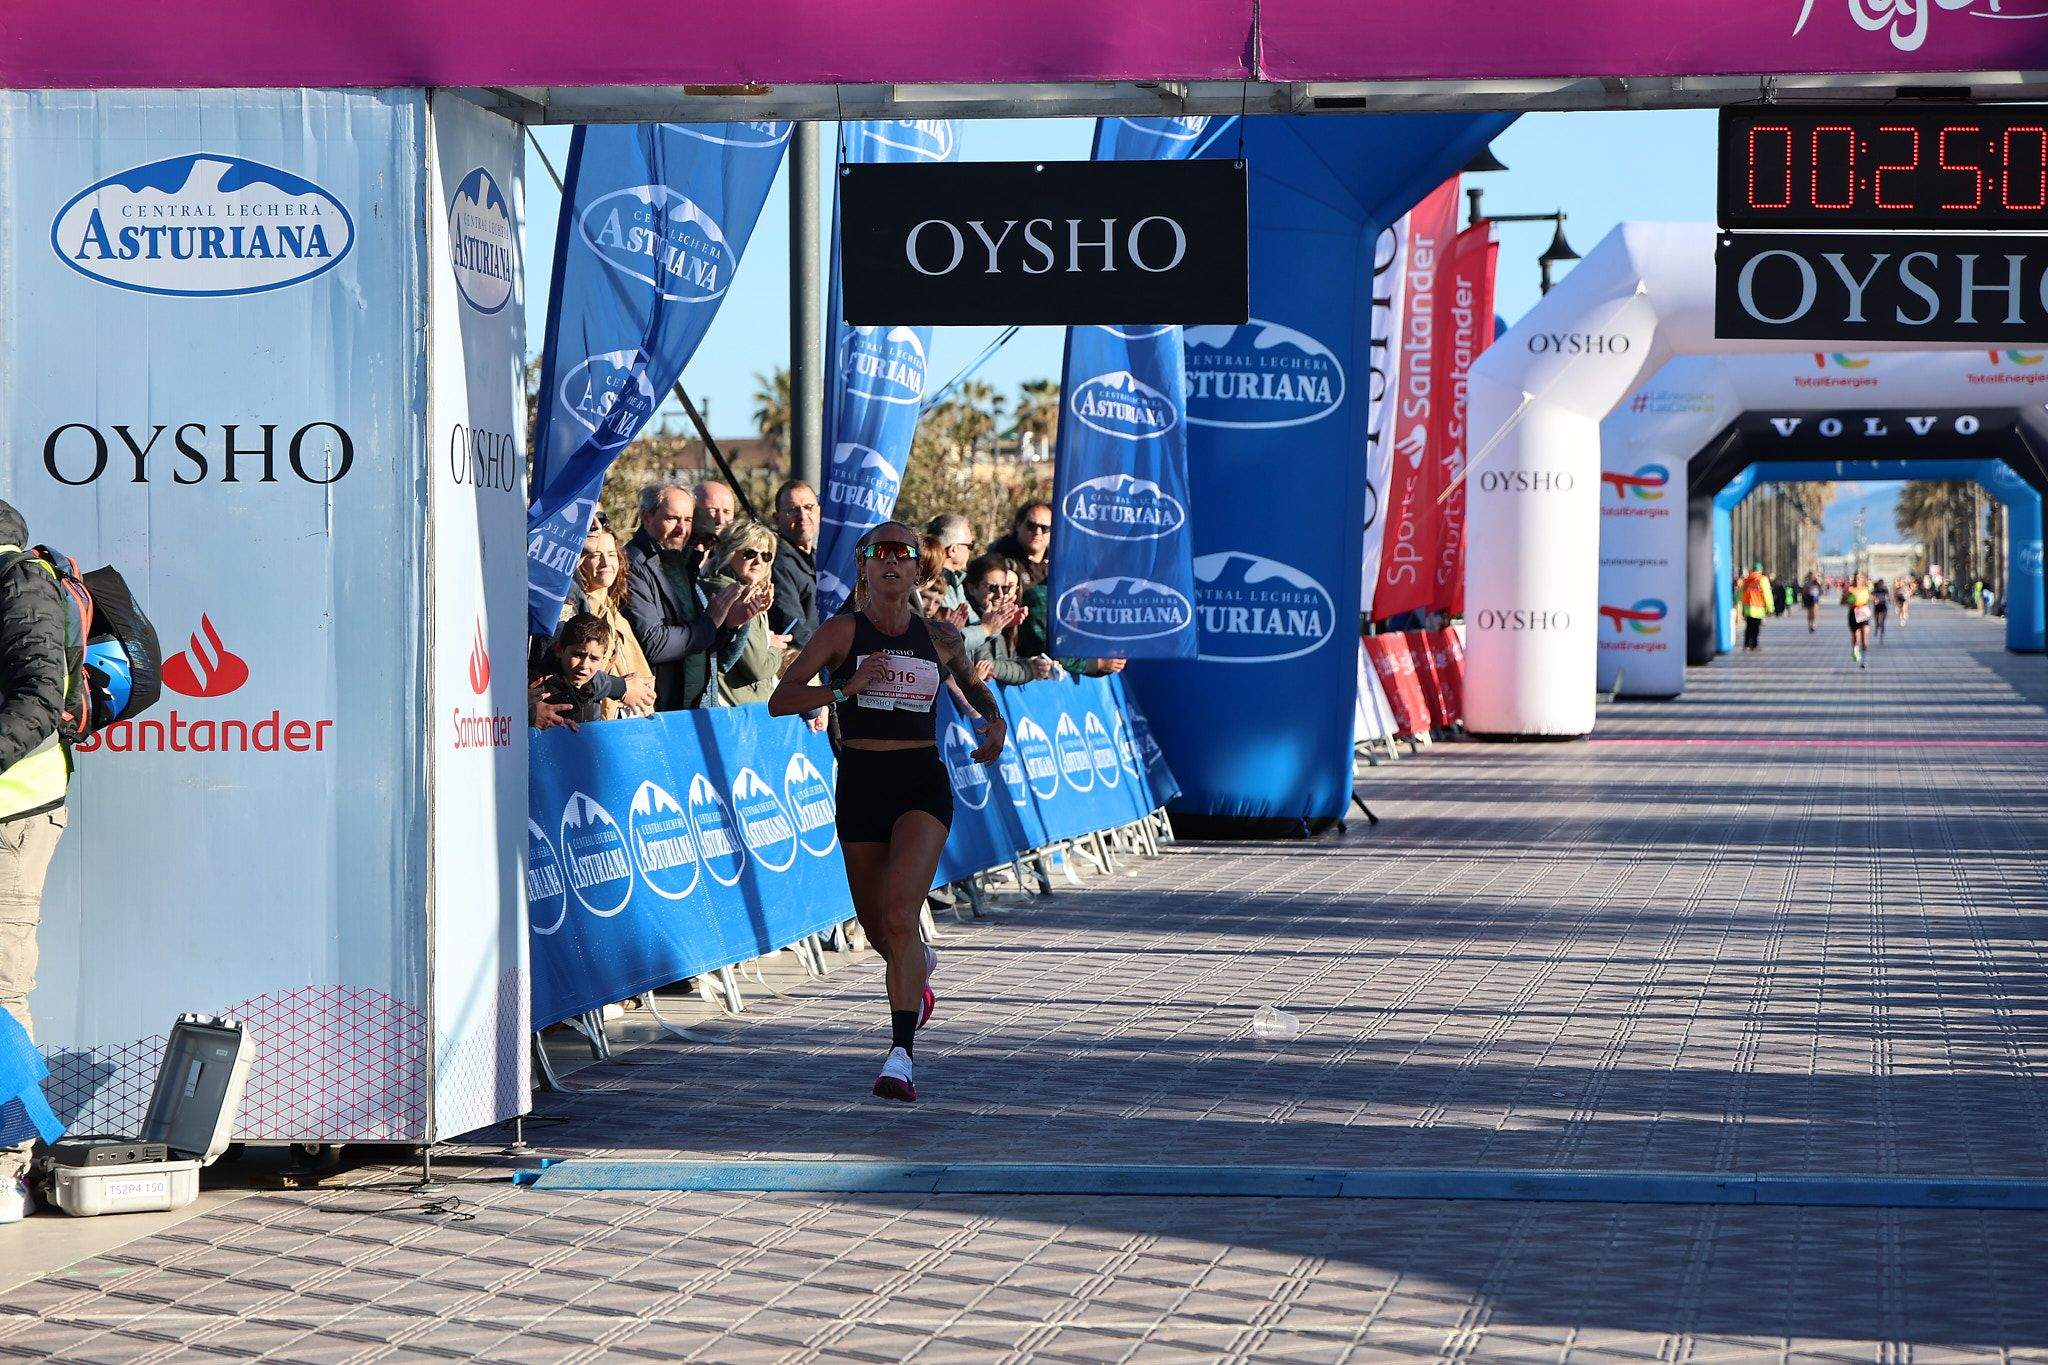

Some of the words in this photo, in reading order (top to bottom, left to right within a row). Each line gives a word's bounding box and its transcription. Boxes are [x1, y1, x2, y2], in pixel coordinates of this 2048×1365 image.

[74, 207, 332, 261] ASTURIANA
[122, 204, 216, 218] CENTRAL
[226, 203, 322, 217] LECHERA
[454, 212, 511, 282] ASTURIANA
[594, 207, 718, 292] ASTIANA
[905, 215, 1187, 276] OYSHO
[1737, 249, 2048, 327] OYSH
[1402, 232, 1436, 420] Santander
[1526, 332, 1631, 355] OYSHO
[1260, 356, 1328, 371] LECHERA
[43, 421, 354, 486] OYSHO
[450, 423, 516, 493] OYSHO
[1480, 470, 1574, 492] OYSHO
[1064, 596, 1184, 625] ASTURIANA
[1250, 590, 1319, 604] LECHERA
[1477, 608, 1571, 632] OYSHO
[453, 706, 512, 749] Santander
[567, 842, 631, 890] ASTURIANA
